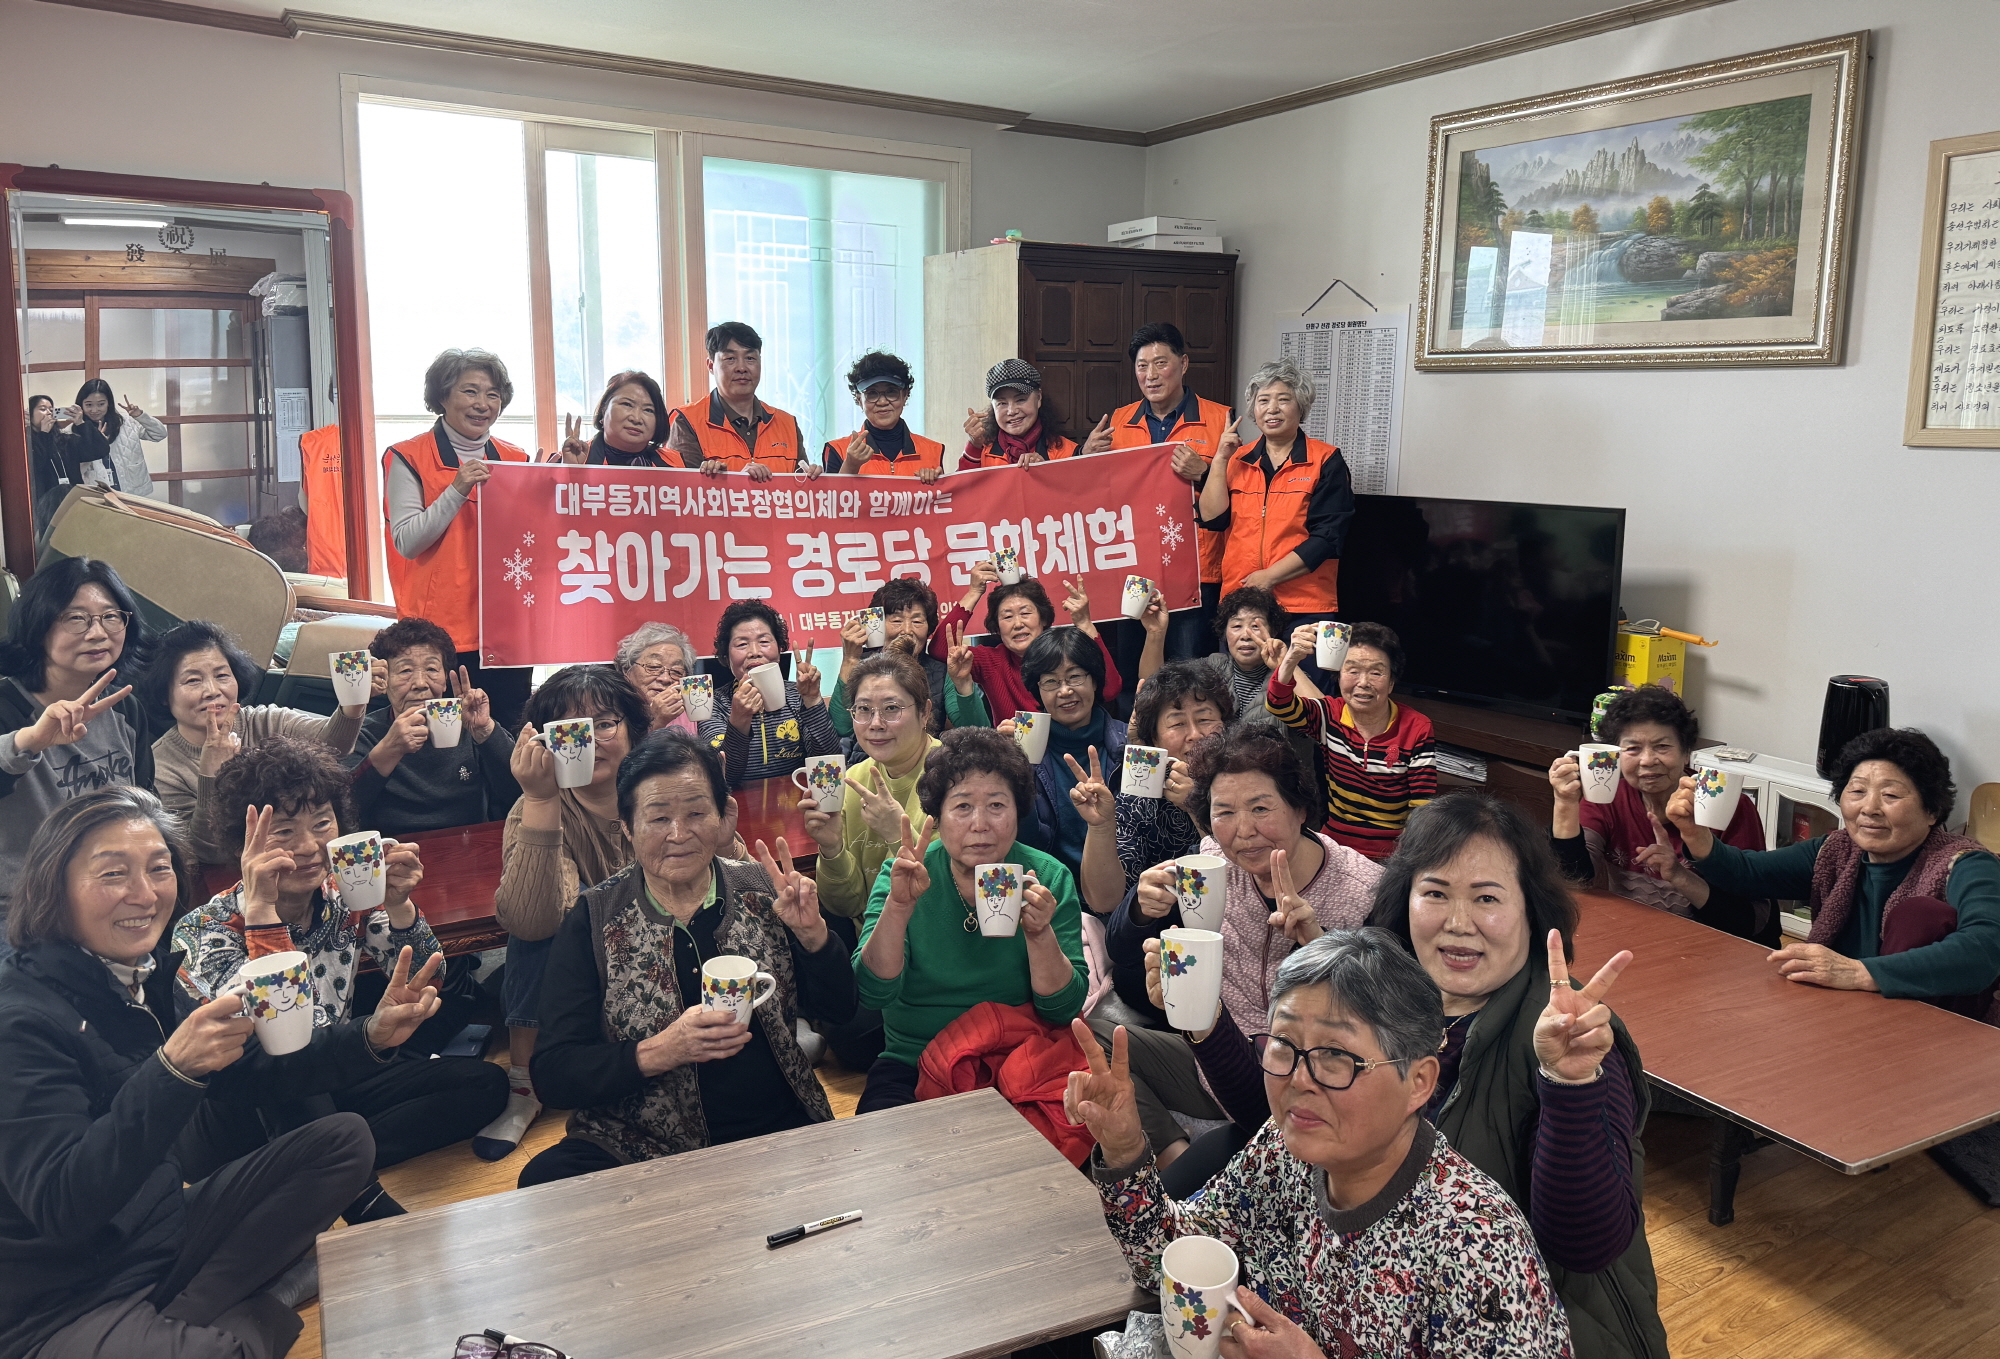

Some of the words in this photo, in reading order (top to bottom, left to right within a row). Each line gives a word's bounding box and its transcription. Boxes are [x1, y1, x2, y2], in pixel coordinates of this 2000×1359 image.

[166, 227, 187, 244] 祝
[555, 482, 862, 519] 대부동지역사회보장협의체와
[869, 489, 953, 518] 함께하는
[556, 529, 773, 605] 찾아가는
[786, 527, 932, 598] 경로당
[945, 504, 1138, 587] 문화체험
[1614, 650, 1635, 662] axim
[1657, 652, 1677, 663] Maxim
